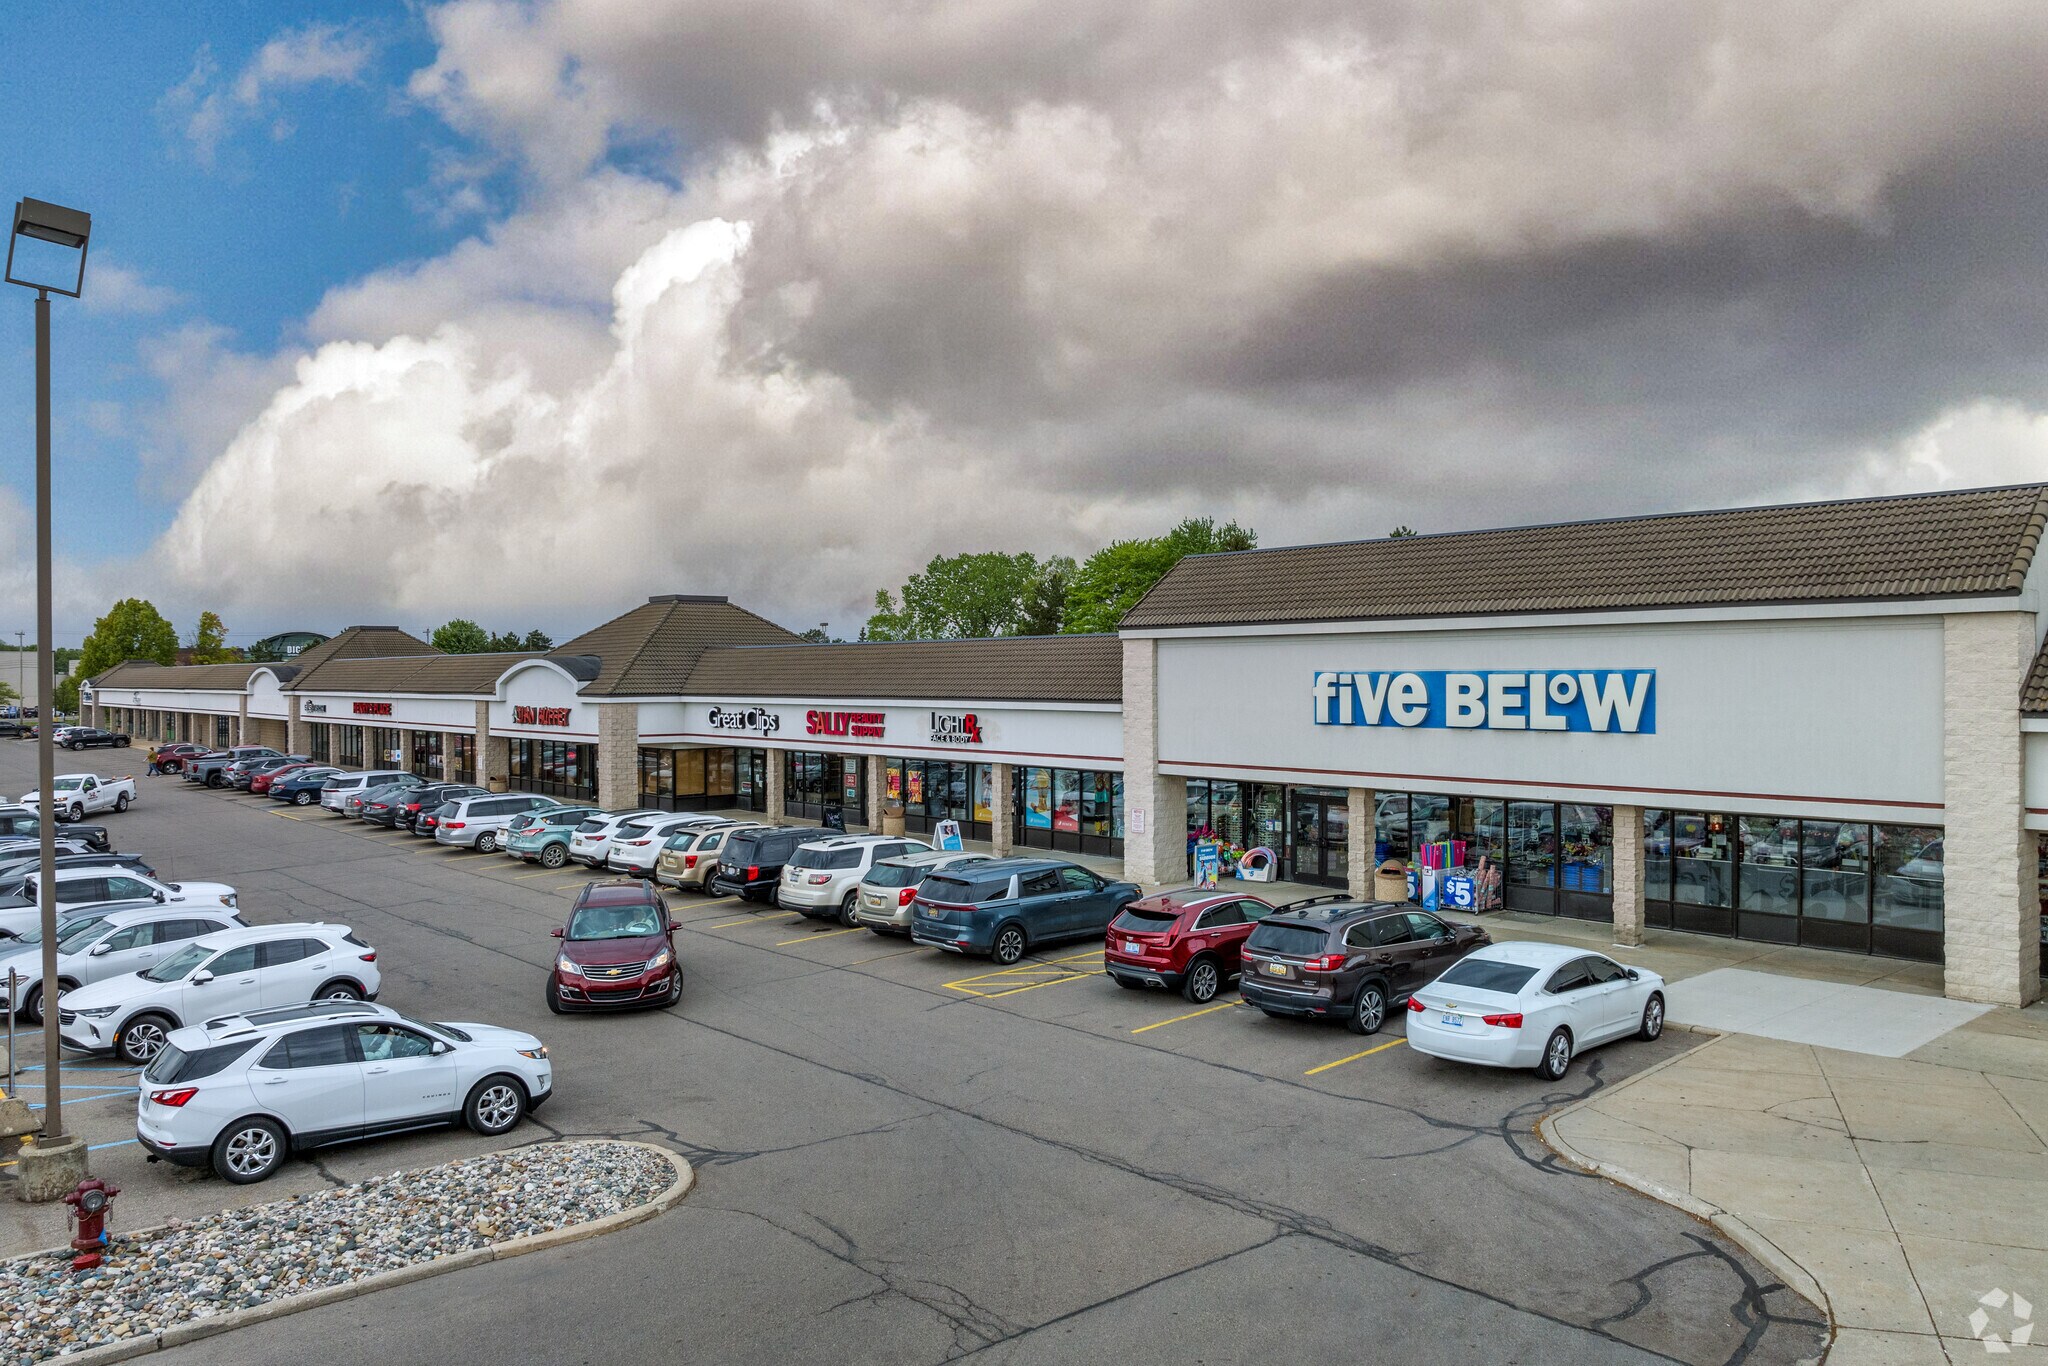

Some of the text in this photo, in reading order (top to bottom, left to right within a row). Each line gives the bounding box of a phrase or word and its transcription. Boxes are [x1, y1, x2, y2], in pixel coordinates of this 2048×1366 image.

[1446, 673, 1655, 732] BELOW
[707, 707, 779, 736] Great Clips
[806, 710, 885, 736] SALLY BEAUTY
[851, 725, 885, 737] SUPPLY
[1446, 880, 1471, 905] $5
